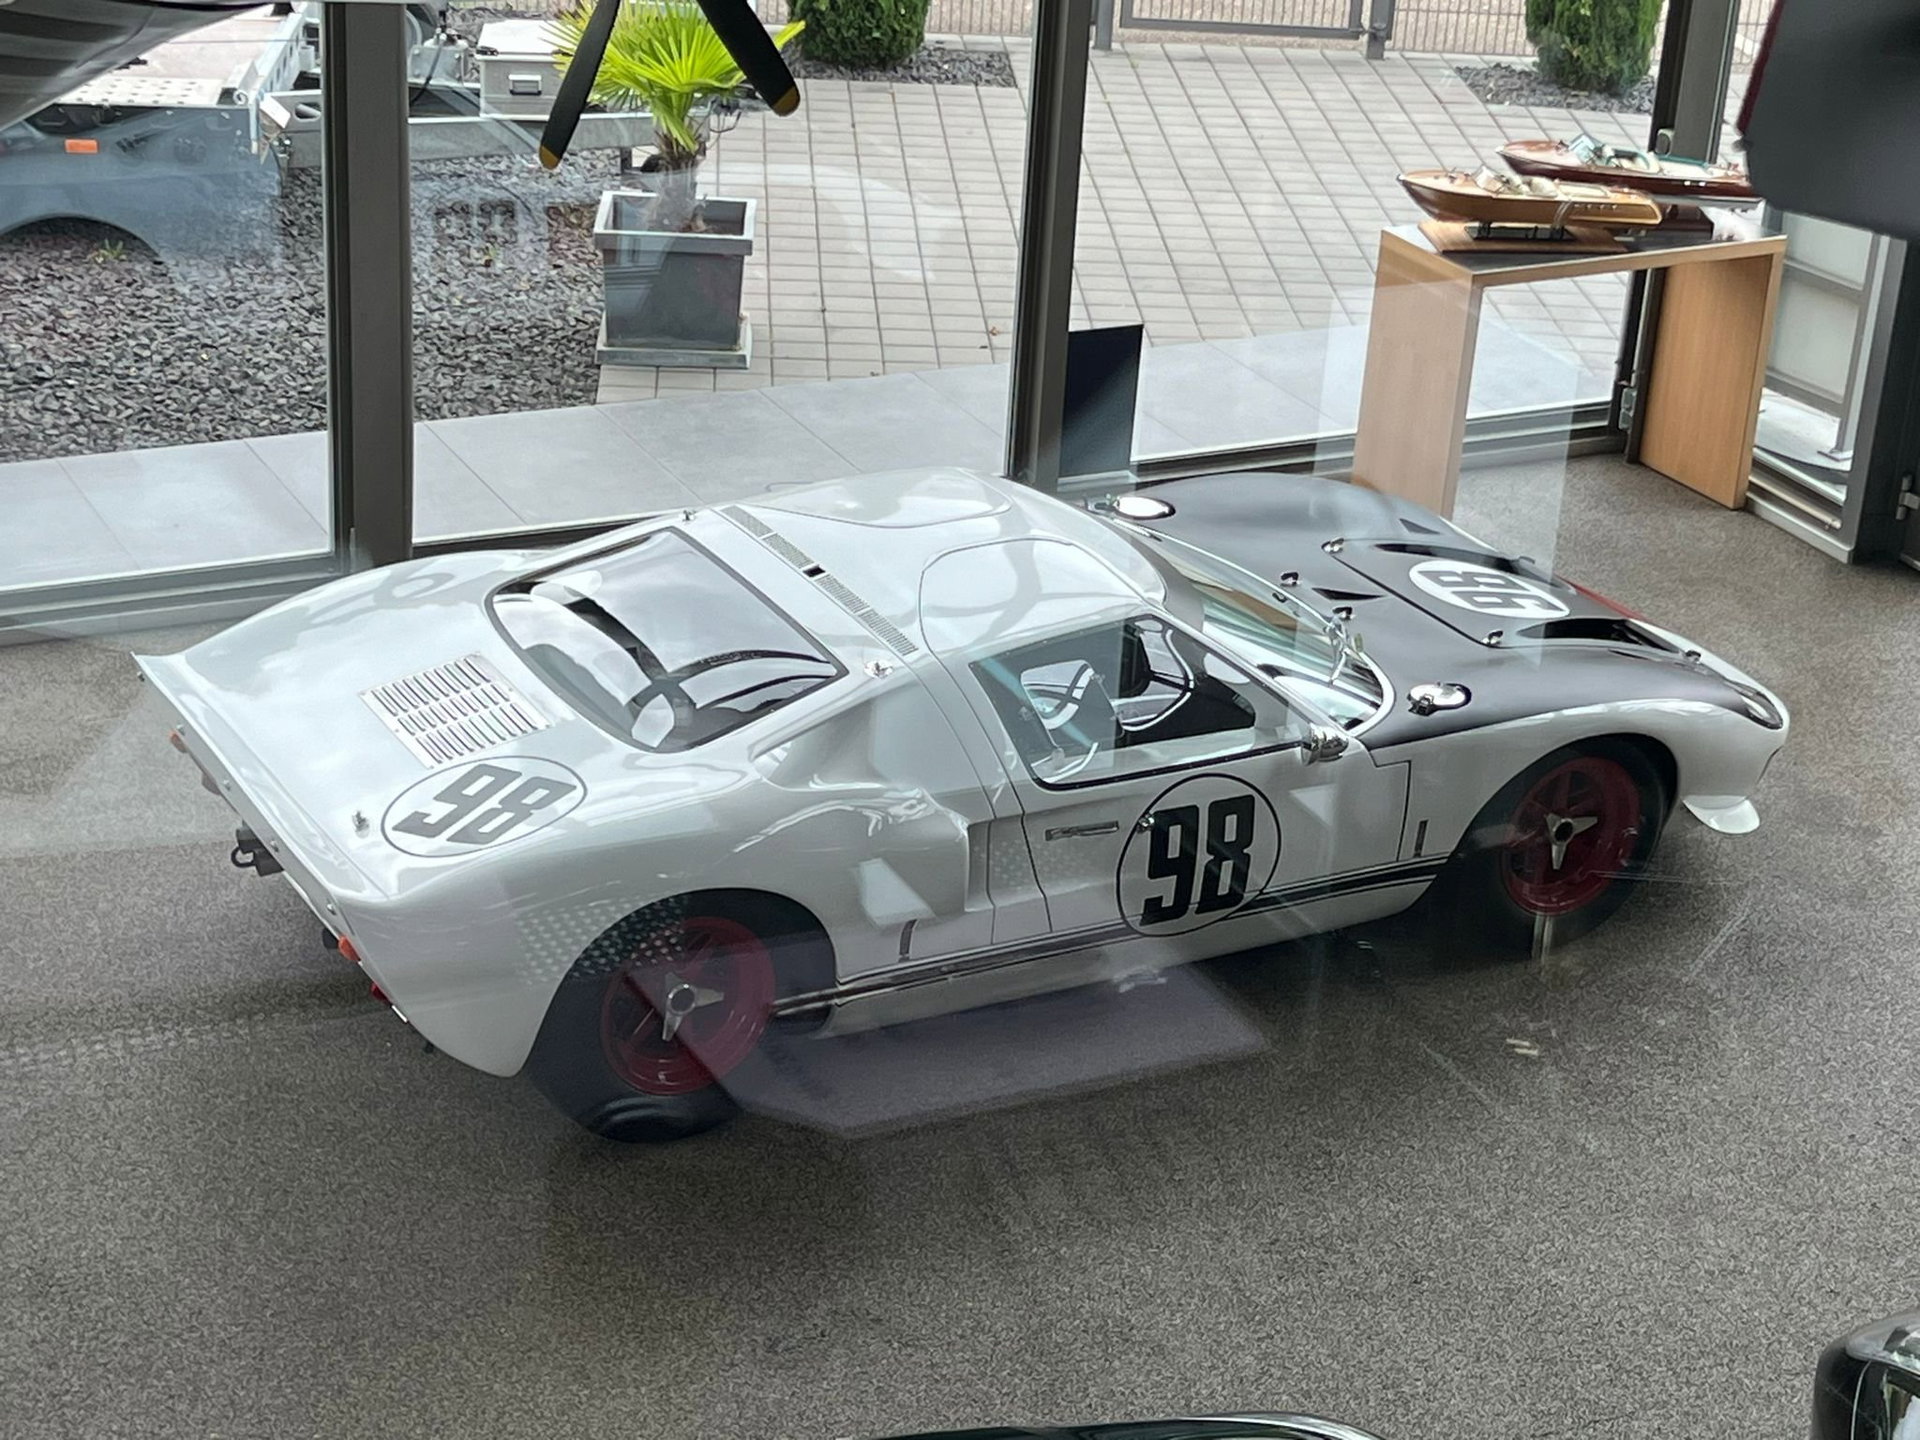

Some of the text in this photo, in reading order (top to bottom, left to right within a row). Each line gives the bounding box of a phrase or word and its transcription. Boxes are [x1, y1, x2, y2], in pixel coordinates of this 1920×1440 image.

[1417, 570, 1566, 611] 98
[391, 763, 578, 845] 98
[1138, 794, 1256, 926] 98
